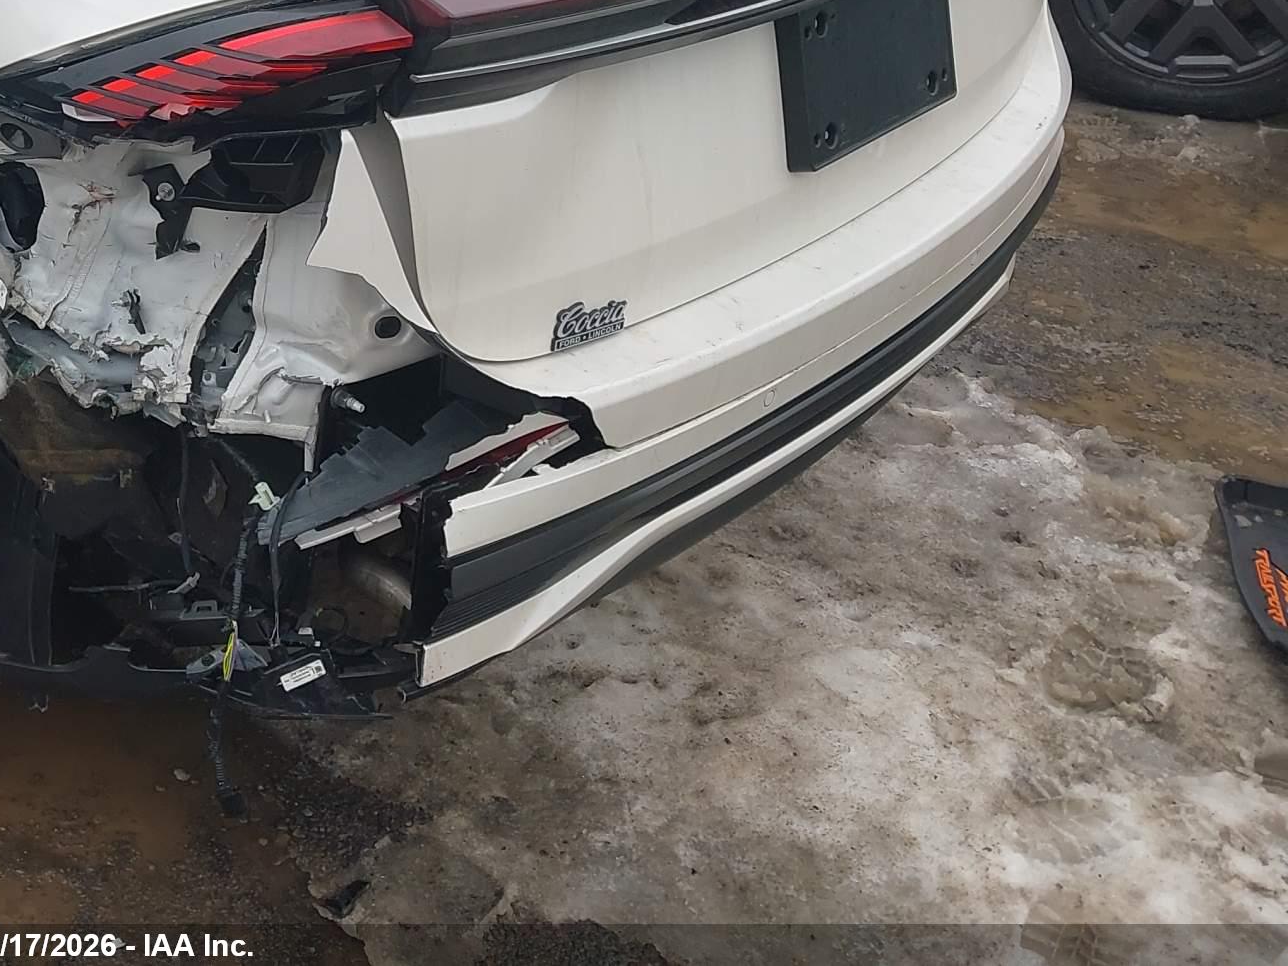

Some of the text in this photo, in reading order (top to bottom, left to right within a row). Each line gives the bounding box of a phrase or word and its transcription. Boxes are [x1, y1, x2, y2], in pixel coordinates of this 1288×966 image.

[556, 302, 625, 338] Coccia
[559, 322, 622, 348] FORD LINCOLN
[1255, 549, 1287, 626] TRAILSPORT
